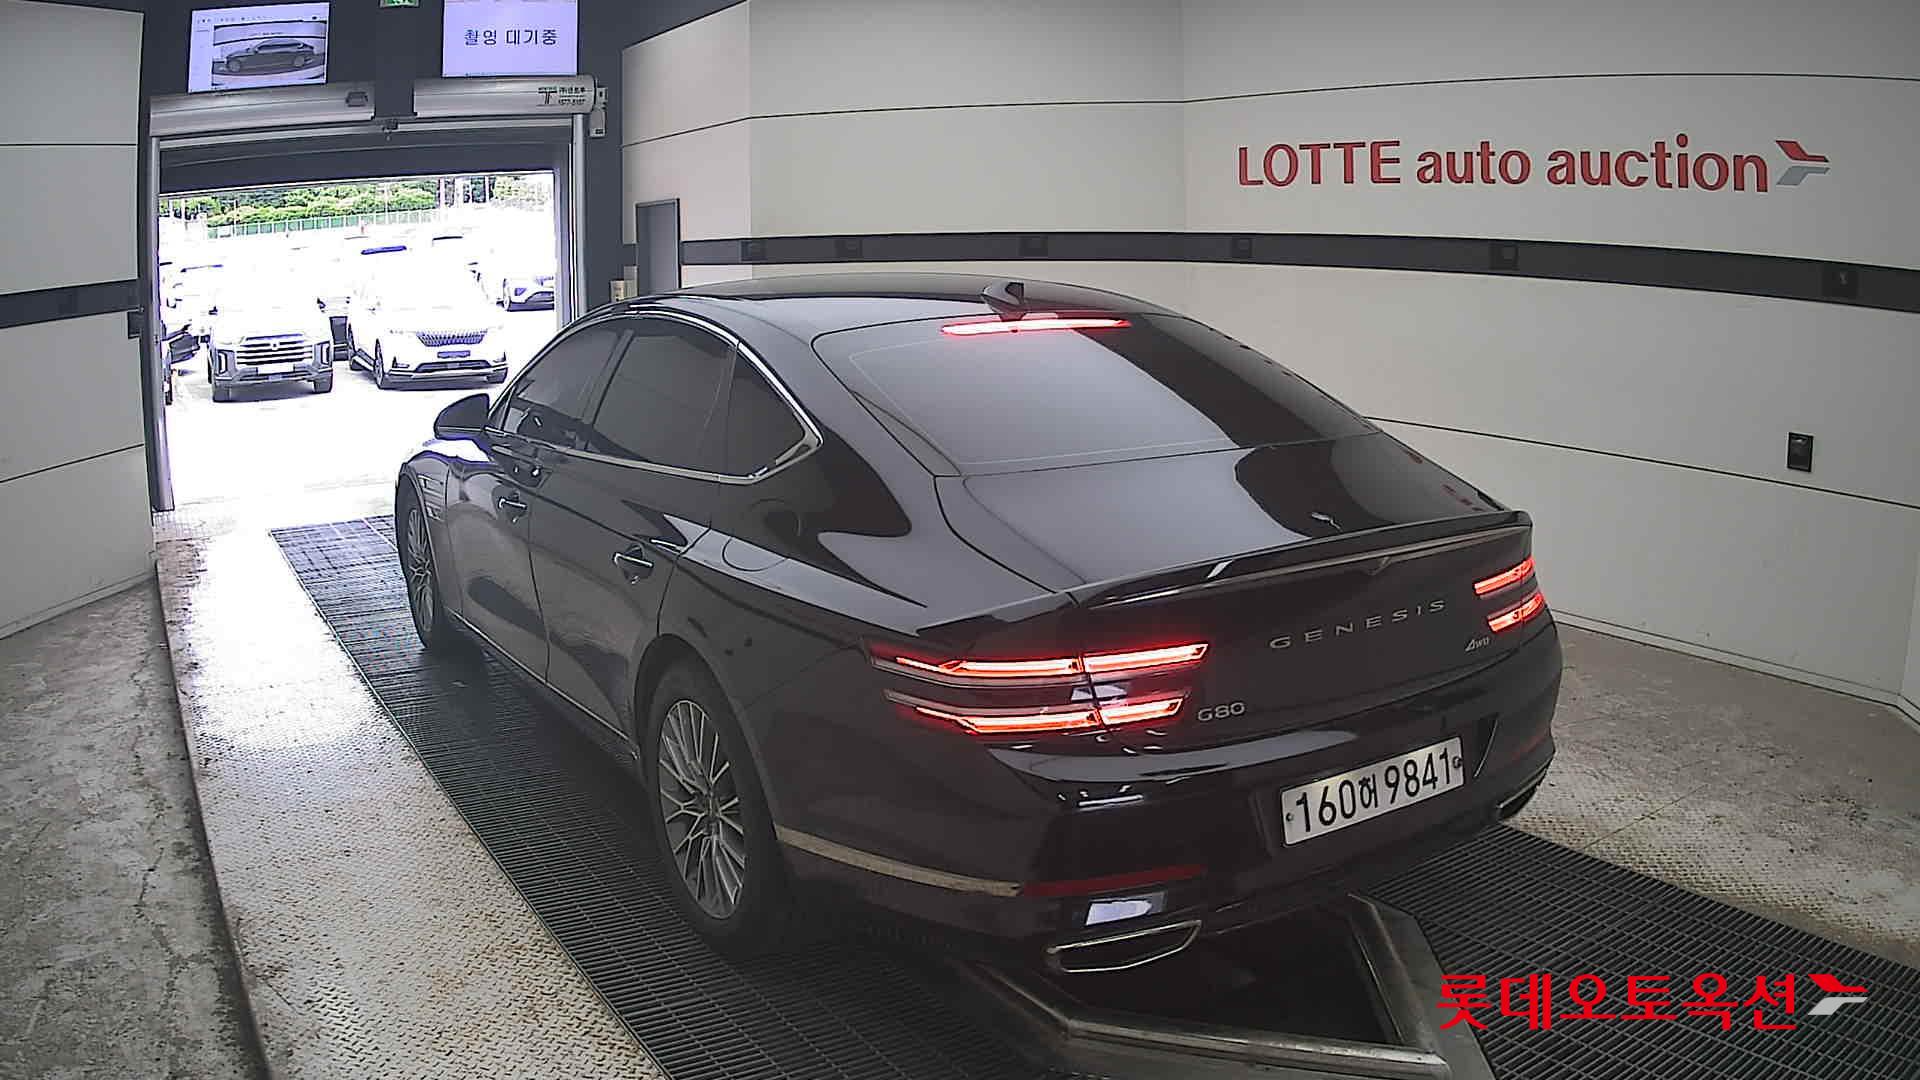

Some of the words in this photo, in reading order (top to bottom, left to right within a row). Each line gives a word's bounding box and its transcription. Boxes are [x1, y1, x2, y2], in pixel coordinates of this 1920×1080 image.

[464, 29, 497, 46] 촬영
[506, 29, 558, 46] 대기중
[1238, 140, 1401, 187] LOTTE
[1416, 141, 1531, 185] auto
[1547, 133, 1768, 193] auction
[1269, 599, 1446, 650] GENESIS
[1197, 701, 1245, 722] G80
[1384, 747, 1451, 804] 9841
